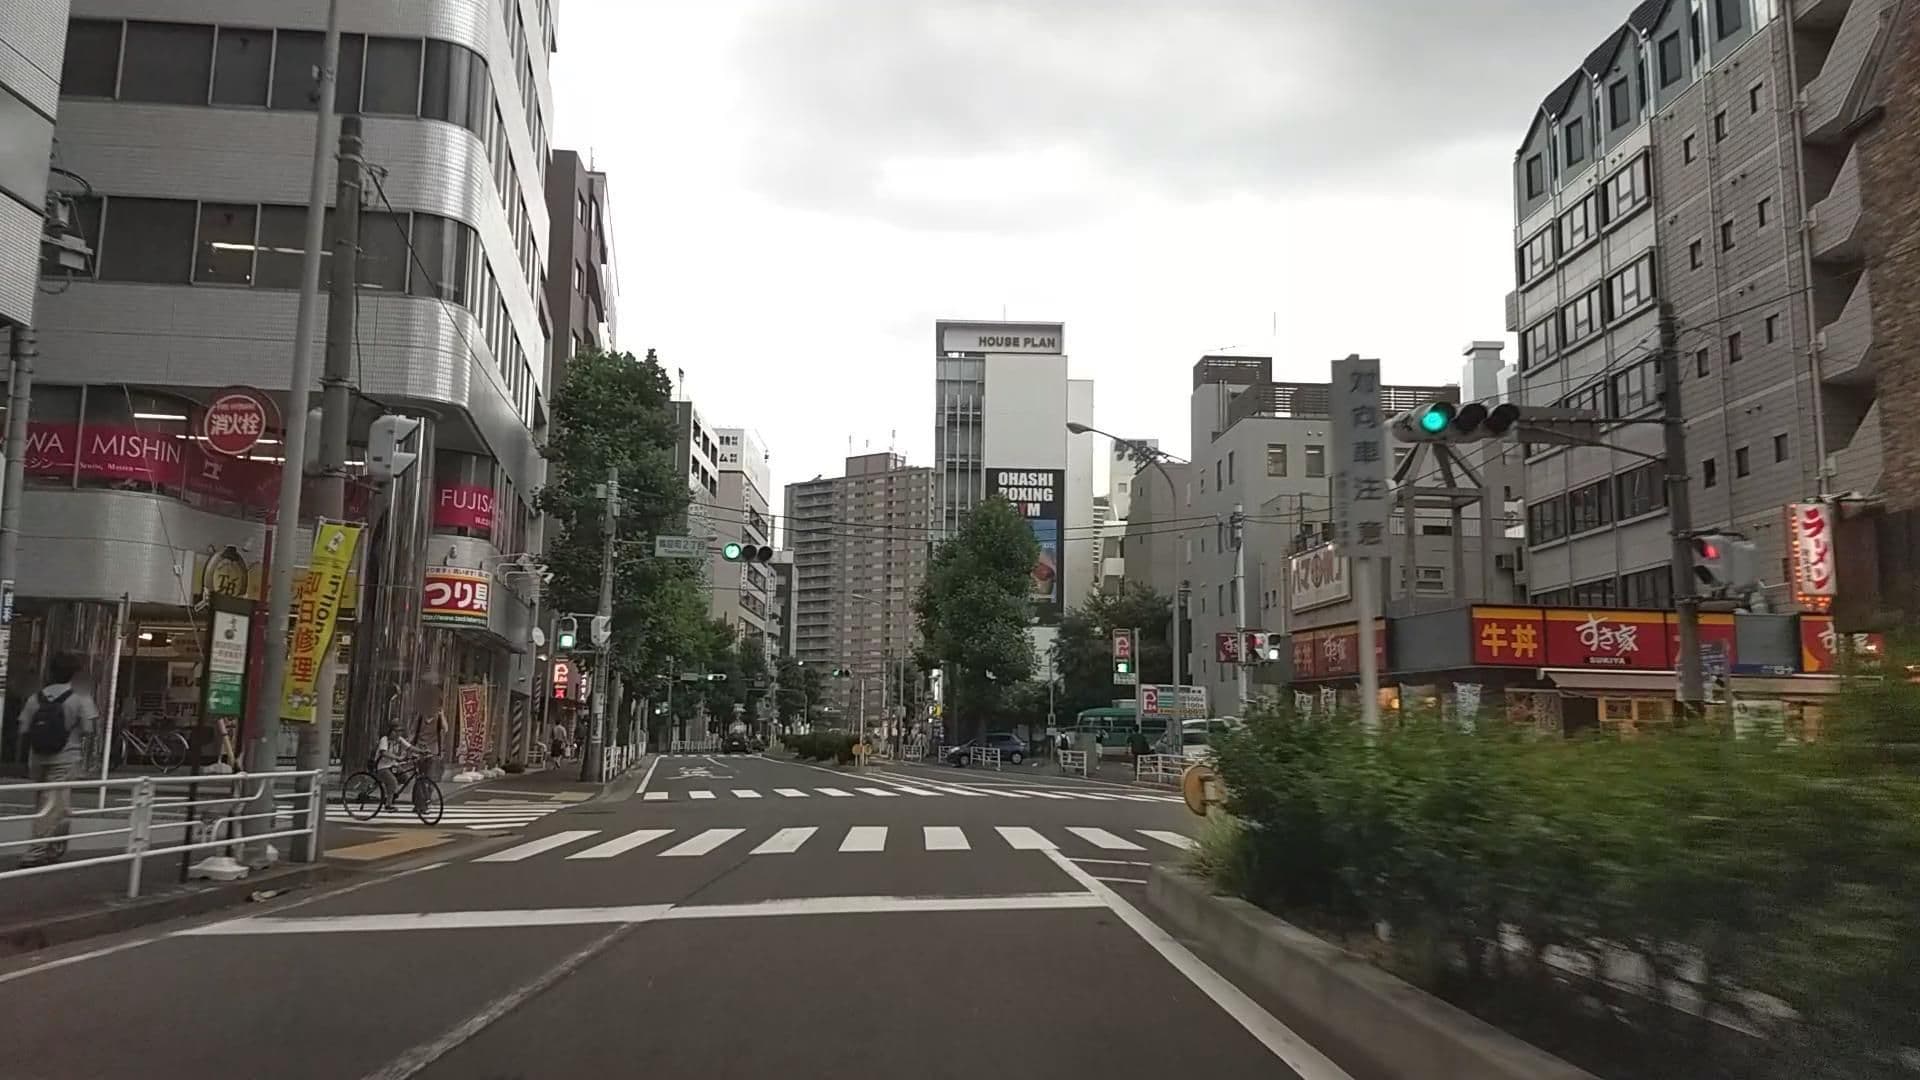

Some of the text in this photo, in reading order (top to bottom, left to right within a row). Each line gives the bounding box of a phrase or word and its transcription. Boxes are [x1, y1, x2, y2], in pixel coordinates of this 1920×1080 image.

[979, 336, 1056, 348] HOUSE PLAN
[210, 412, 261, 435] 消火栓
[91, 433, 182, 464] MISHIN
[998, 472, 1054, 487] OHASHI
[1803, 508, 1830, 590] ラーメン
[424, 582, 488, 611] つり具
[1481, 622, 1539, 658] 牛丼
[1575, 613, 1640, 657] すき家
